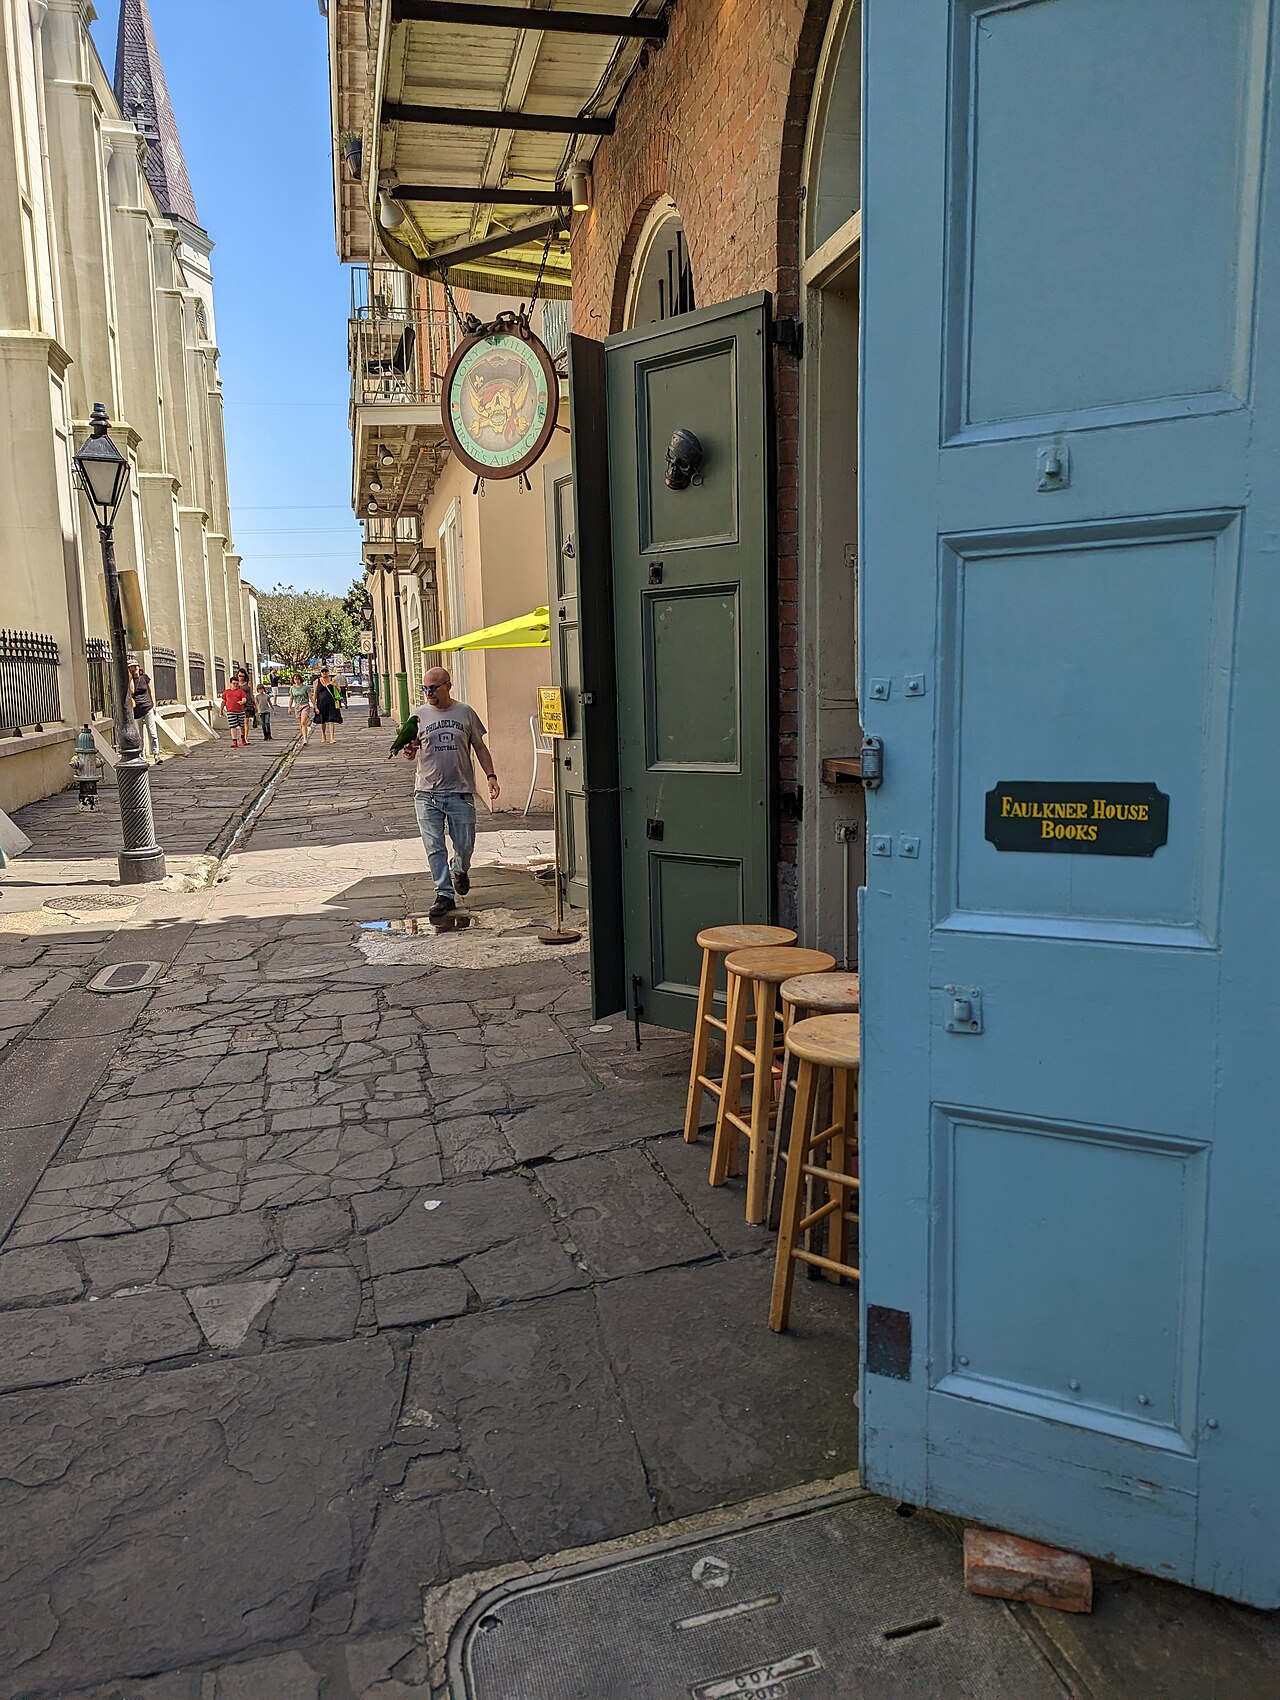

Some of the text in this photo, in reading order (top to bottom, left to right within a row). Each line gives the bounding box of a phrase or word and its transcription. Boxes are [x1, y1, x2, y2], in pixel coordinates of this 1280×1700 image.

[453, 349, 479, 390] TONY
[453, 415, 487, 463] PIRATE'S
[489, 449, 524, 466] ALLEY
[425, 719, 465, 734] PHILADELPHIA
[1001, 797, 1149, 821] FAULKNER HOUSE
[1041, 820, 1098, 841] BOOKS
[735, 1667, 776, 1688] COX
